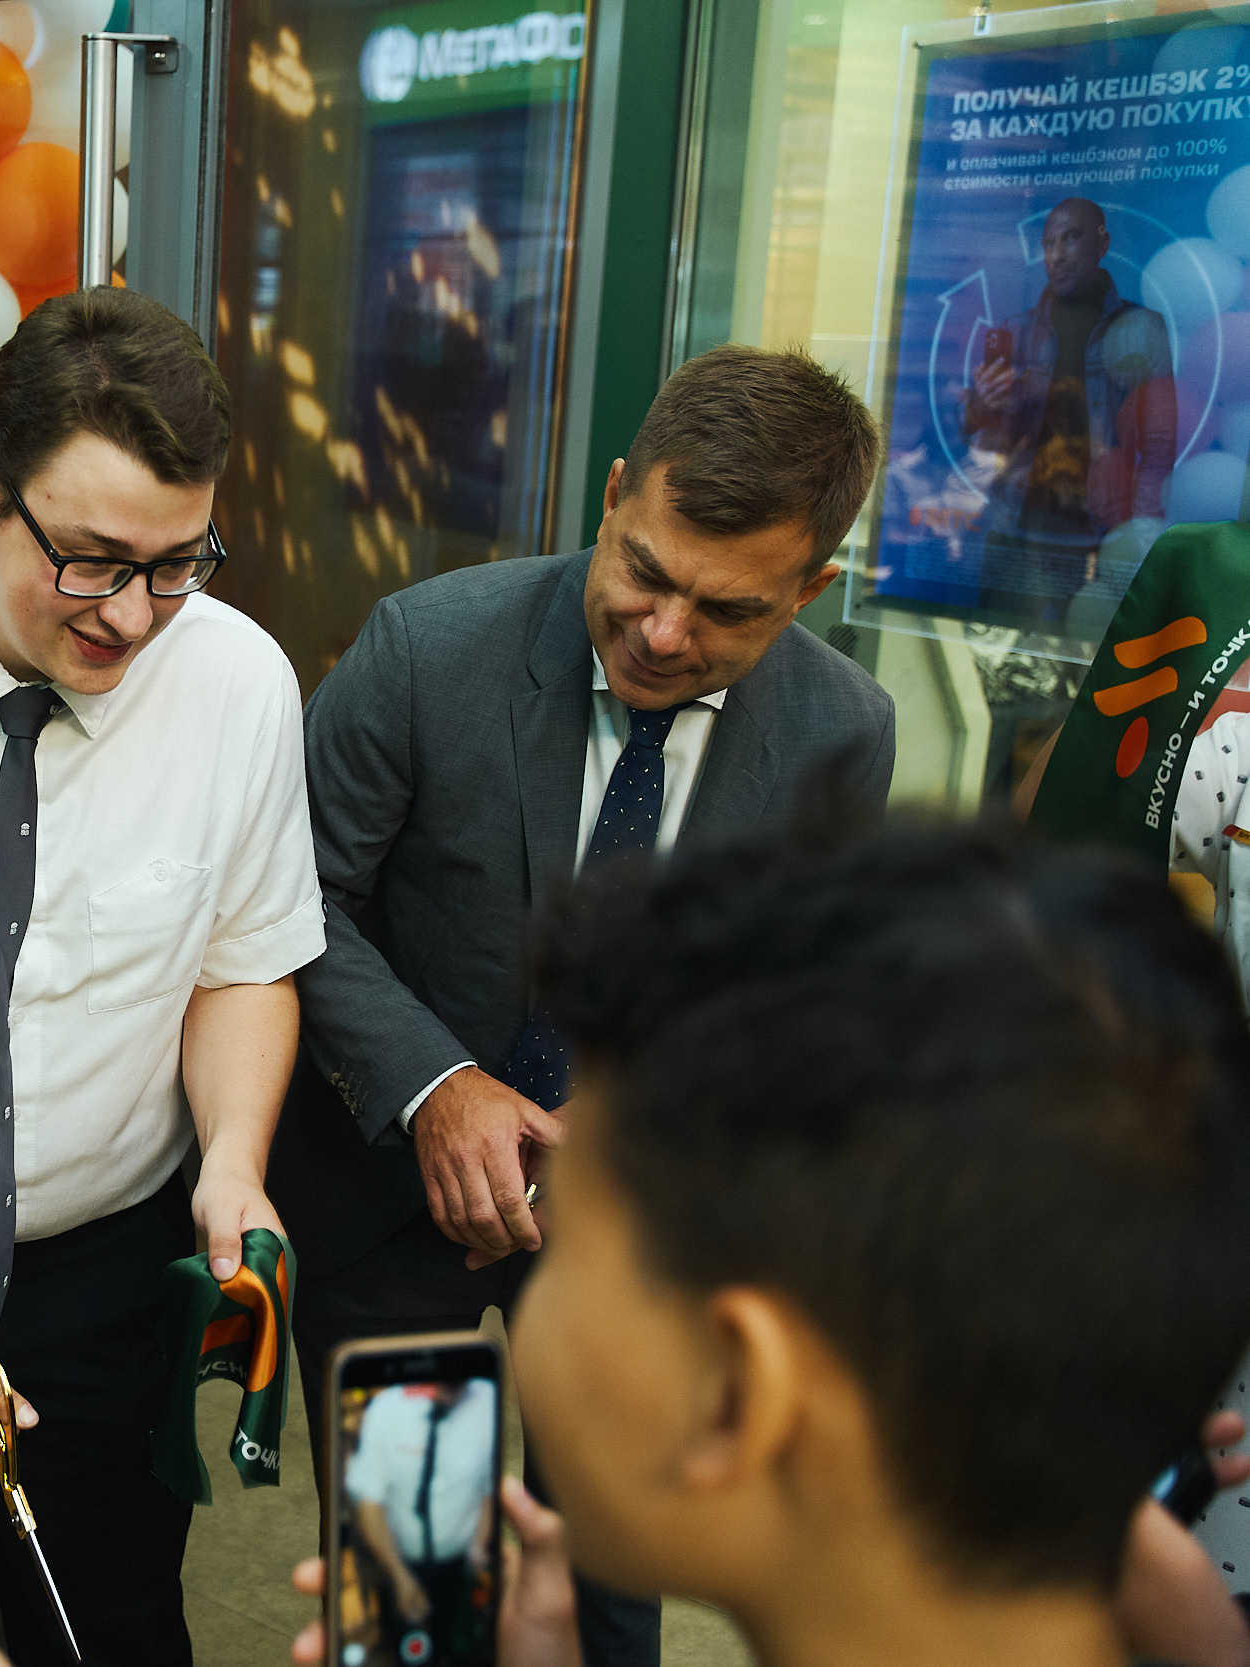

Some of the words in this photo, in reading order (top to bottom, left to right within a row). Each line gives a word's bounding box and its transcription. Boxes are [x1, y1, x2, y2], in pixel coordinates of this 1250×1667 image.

[953, 75, 1078, 114] ПОЛУЧАЙ
[1085, 68, 1208, 102] КЕШБЭК
[950, 119, 982, 142] ЗА
[988, 108, 1115, 138] КАЖДУЮ
[1122, 95, 1250, 128] ПОКУПК
[946, 159, 956, 171] и
[960, 151, 1047, 170] оплачивай
[1052, 146, 1142, 165] кешбэком
[1145, 146, 1169, 161] до
[1175, 137, 1227, 155] 100%
[944, 172, 1030, 191] стоимости
[1034, 163, 1135, 187] следующей
[1140, 163, 1219, 183] покупки
[1145, 733, 1182, 830] ВКУСНО
[1188, 690, 1206, 710] И
[1201, 619, 1250, 685] ТОЧК
[235, 1426, 280, 1470] ТОЧК
